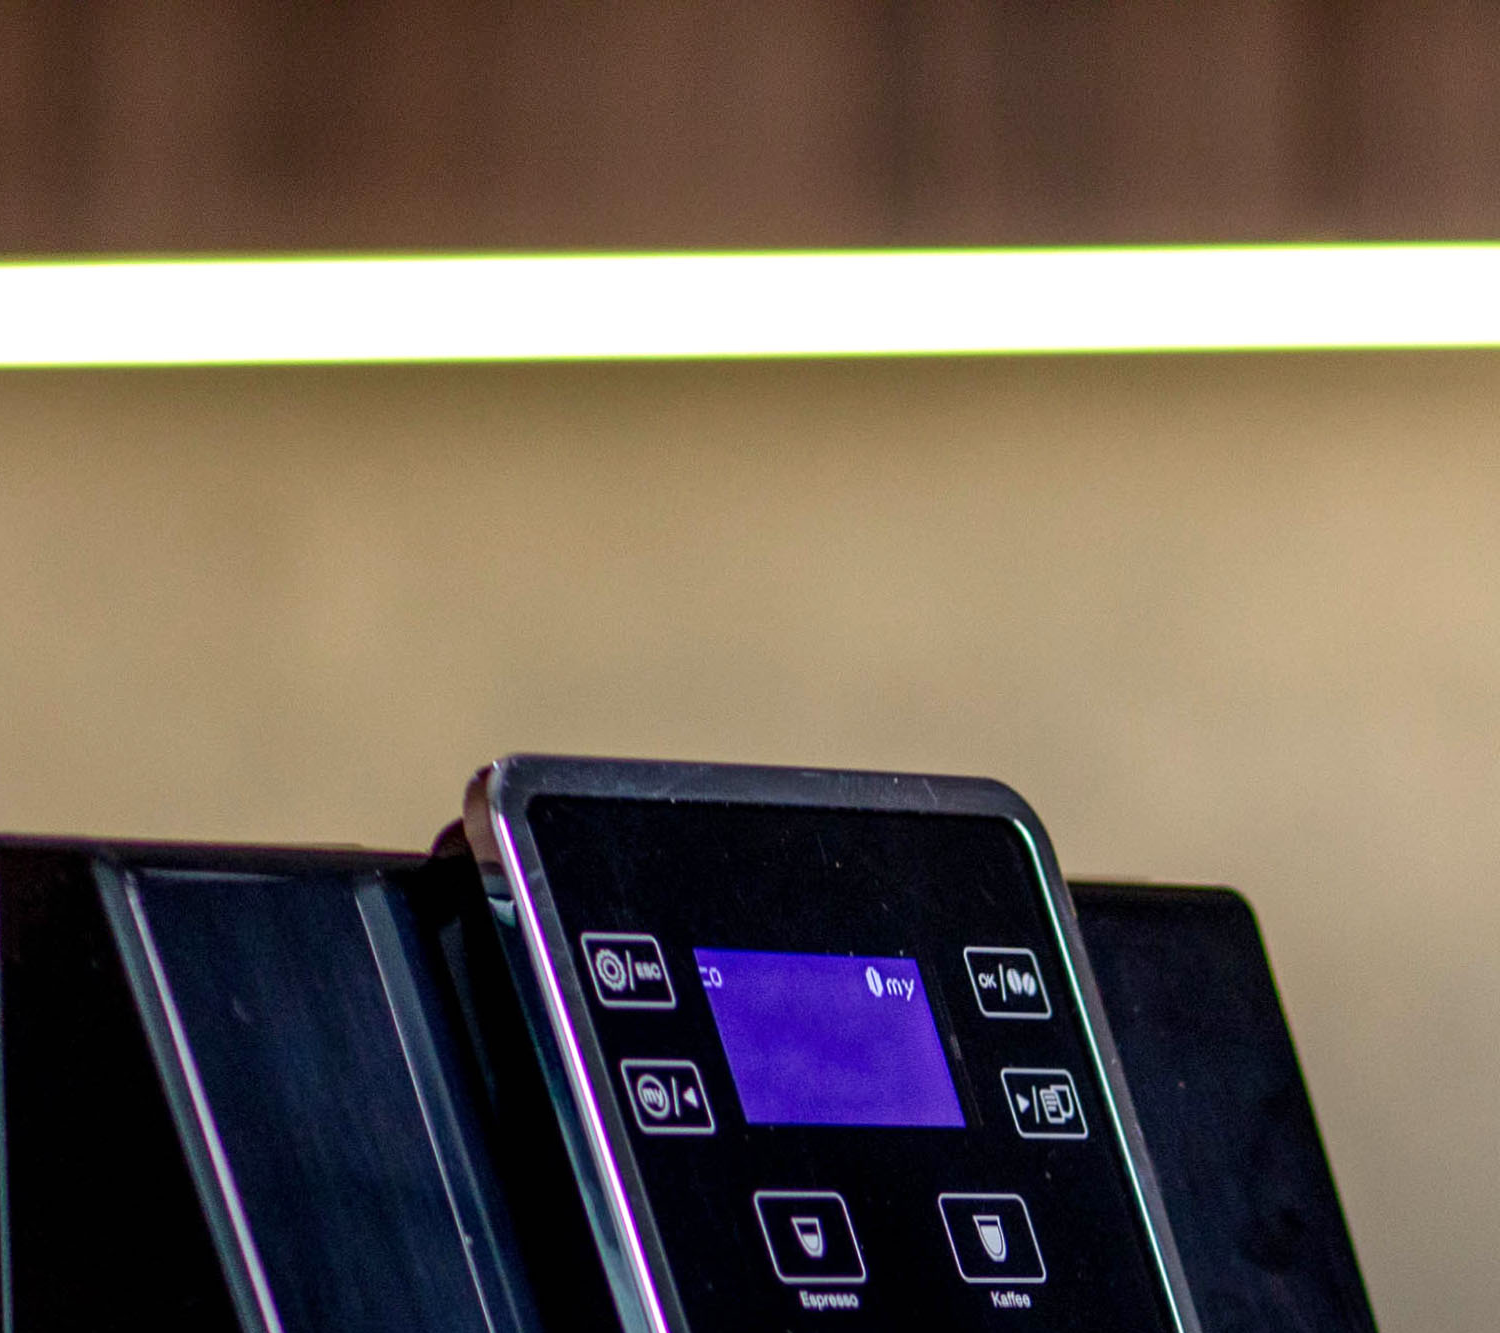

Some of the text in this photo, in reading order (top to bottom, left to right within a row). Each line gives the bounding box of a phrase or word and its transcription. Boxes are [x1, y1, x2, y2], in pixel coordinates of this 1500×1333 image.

[886, 977, 914, 1001] my
[978, 972, 997, 990] OK
[800, 1290, 858, 1310] Espresso
[990, 1290, 1031, 1308] Kaffee
